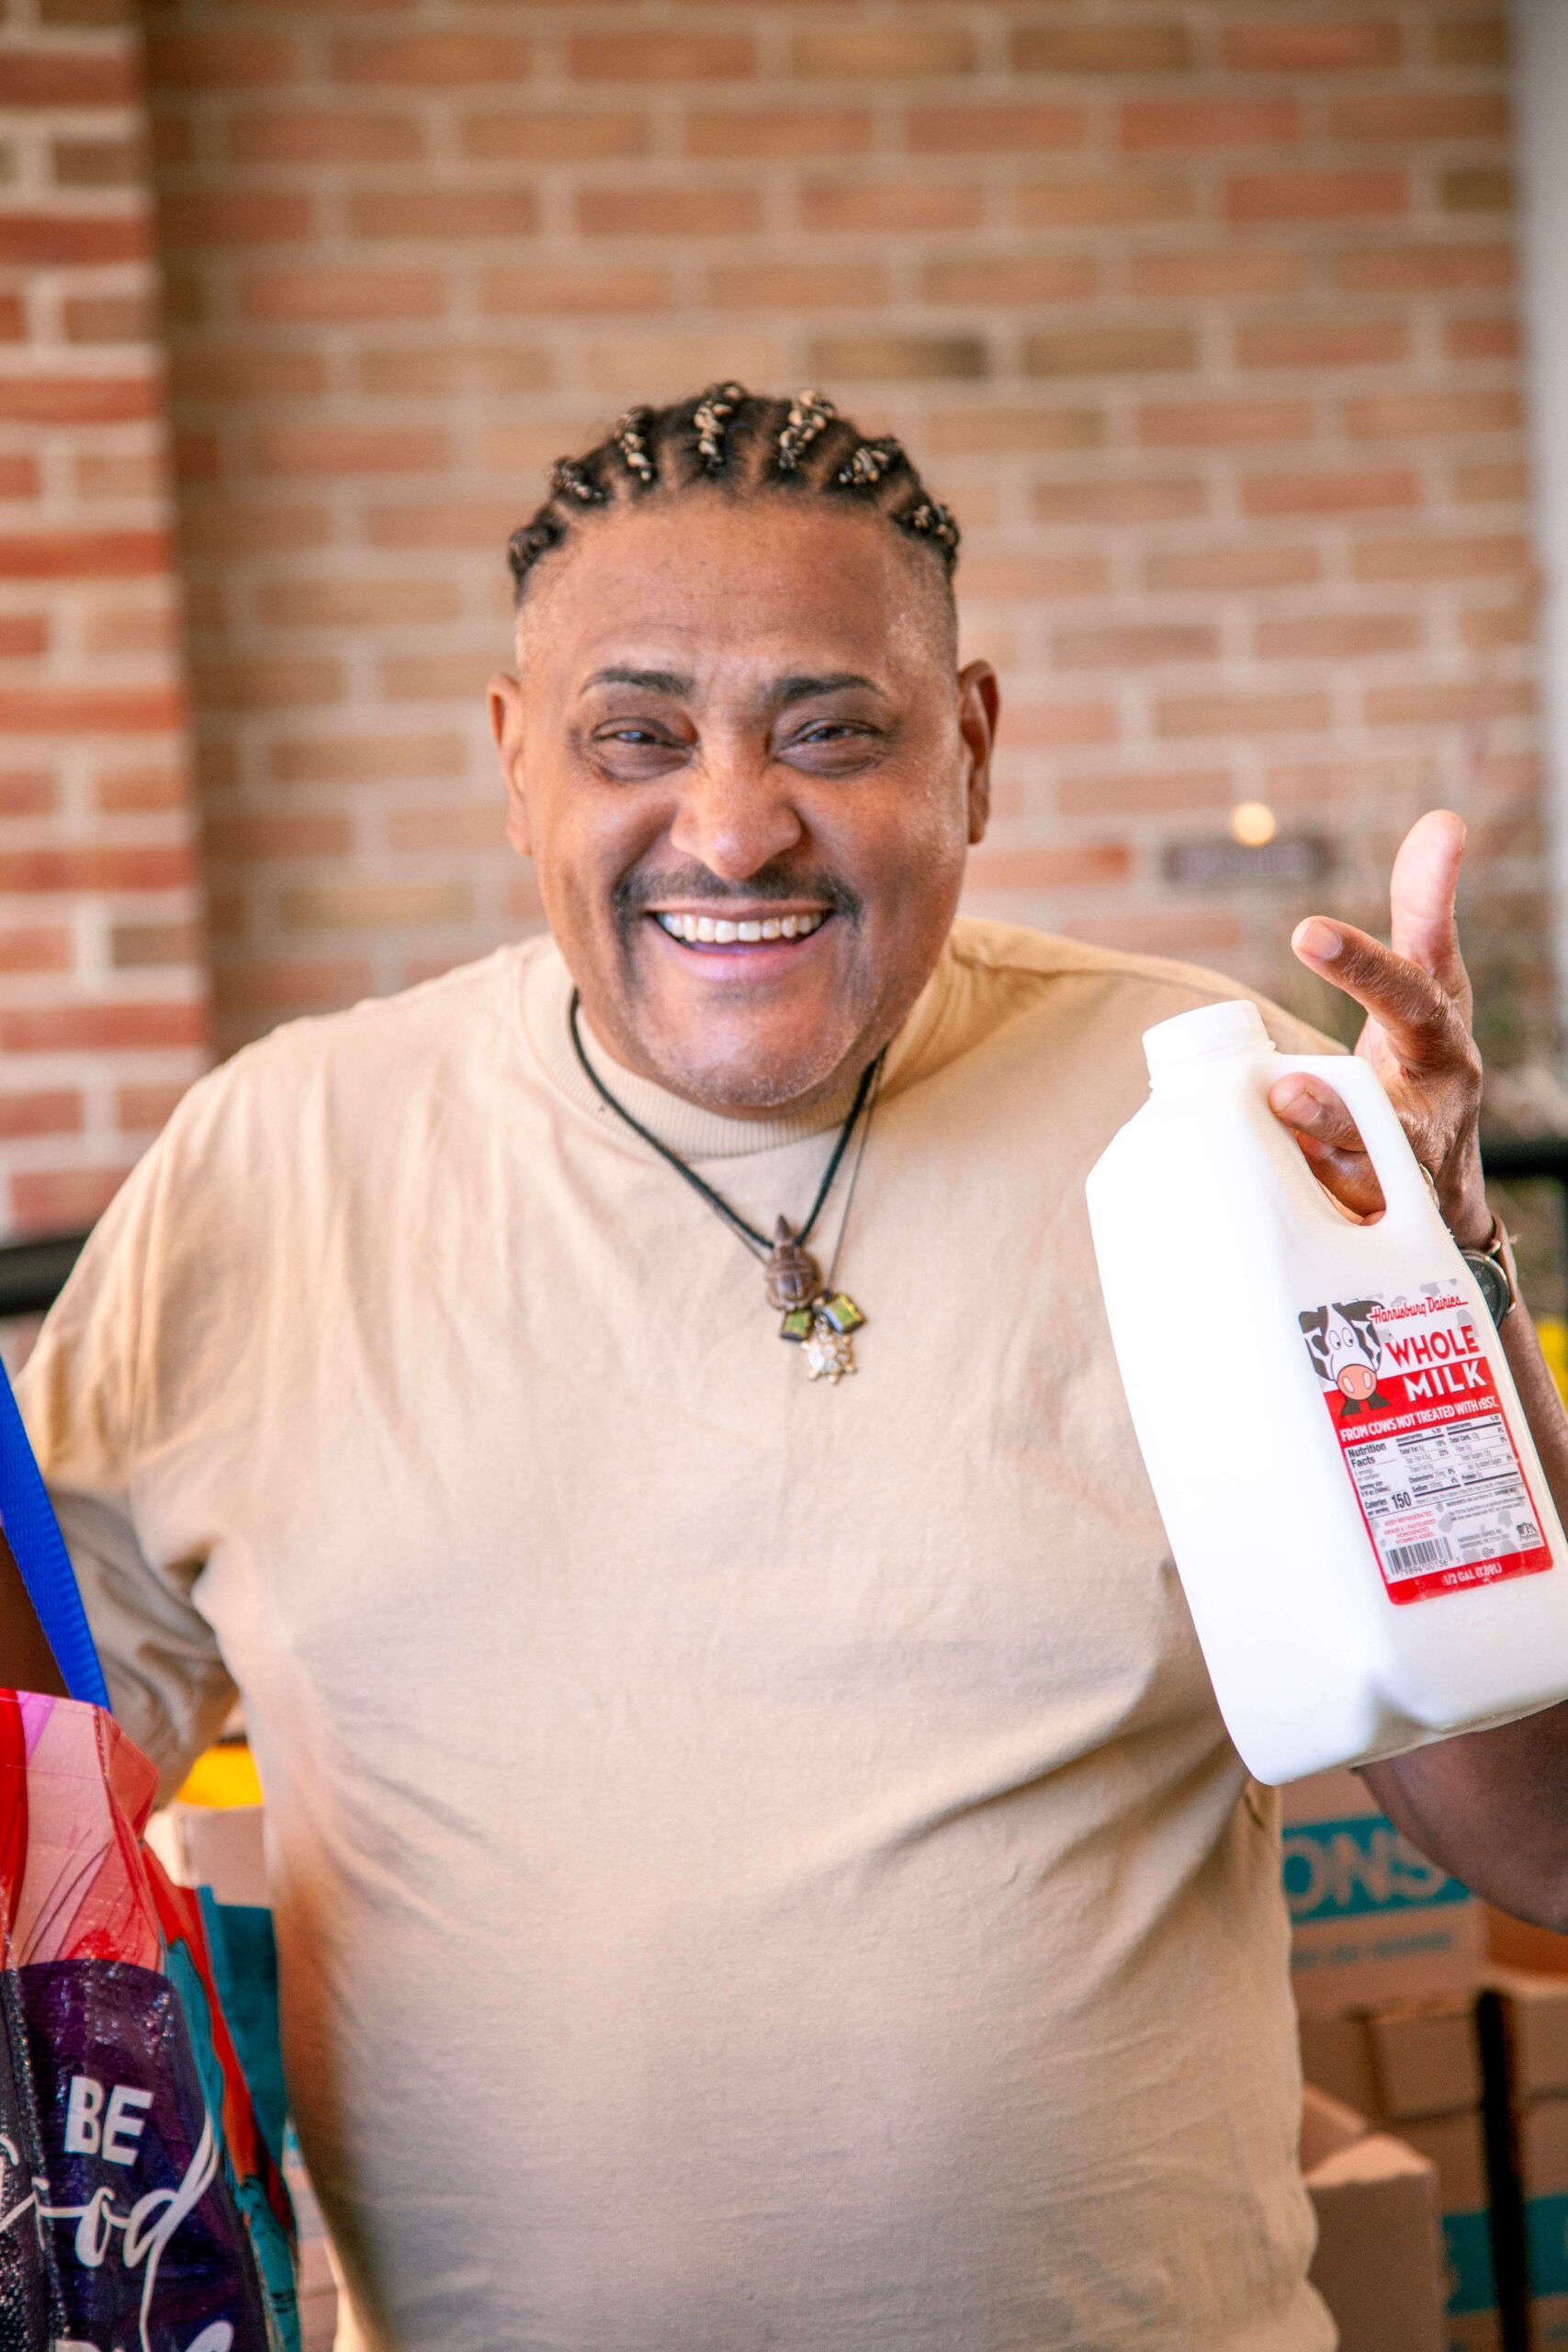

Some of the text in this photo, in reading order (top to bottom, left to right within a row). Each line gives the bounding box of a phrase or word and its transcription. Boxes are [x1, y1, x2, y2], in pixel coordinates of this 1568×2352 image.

[1370, 1295, 1468, 1323] Harrisburg Dairies
[1384, 1325, 1480, 1367] WHOLE
[1403, 1361, 1487, 1402] MILK
[1340, 1424, 1368, 1442] FROM
[1368, 1418, 1396, 1435] COWS
[1396, 1415, 1416, 1429] NOT
[1416, 1406, 1455, 1423] TREATED
[1455, 1399, 1480, 1415] WITH
[1348, 1442, 1387, 1459] Nutrition
[1350, 1455, 1376, 1468] Facts
[1392, 1491, 1412, 1510] 150
[1458, 1569, 1475, 1581] GAL
[64, 2075, 154, 2166] BE
